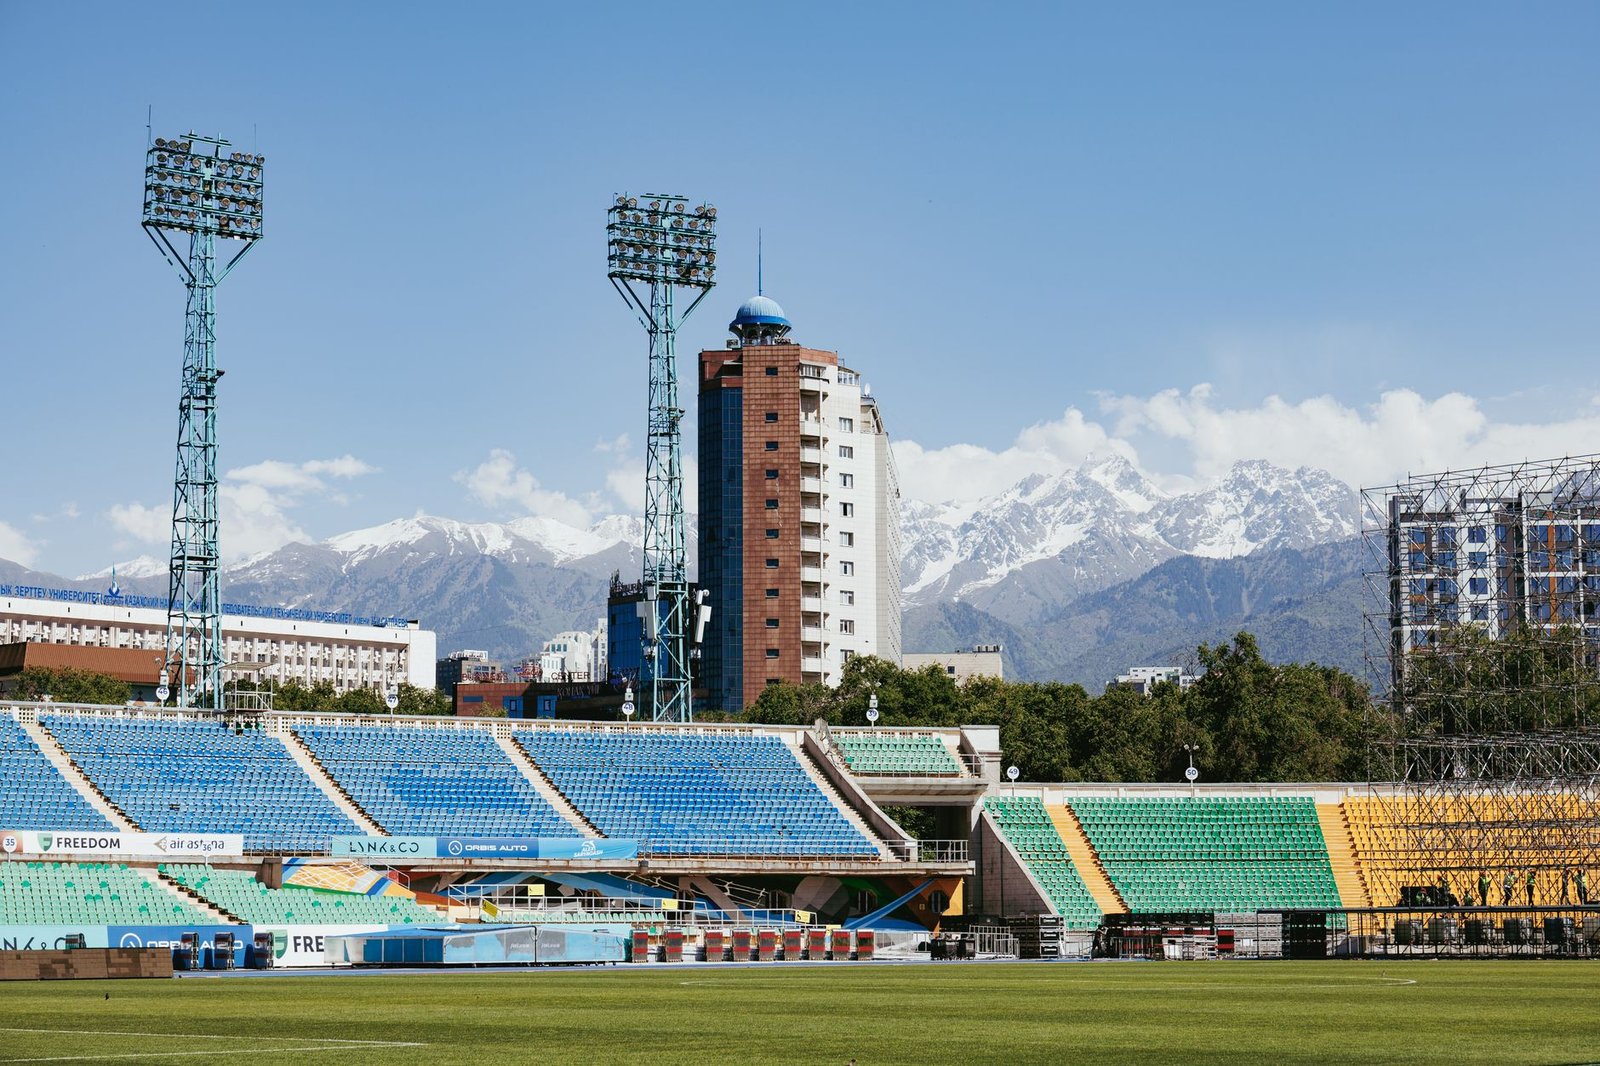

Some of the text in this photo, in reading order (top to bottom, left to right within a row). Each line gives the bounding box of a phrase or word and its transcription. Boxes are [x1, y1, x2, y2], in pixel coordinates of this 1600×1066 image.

[14, 585, 47, 599] ЗЕРТТЕУ
[5, 838, 16, 847] 35
[56, 837, 121, 849] FREEDOM
[170, 837, 225, 850] air astna
[202, 843, 212, 851] 36
[464, 844, 529, 852] ORBIS AUTO
[293, 935, 325, 953] FRE
